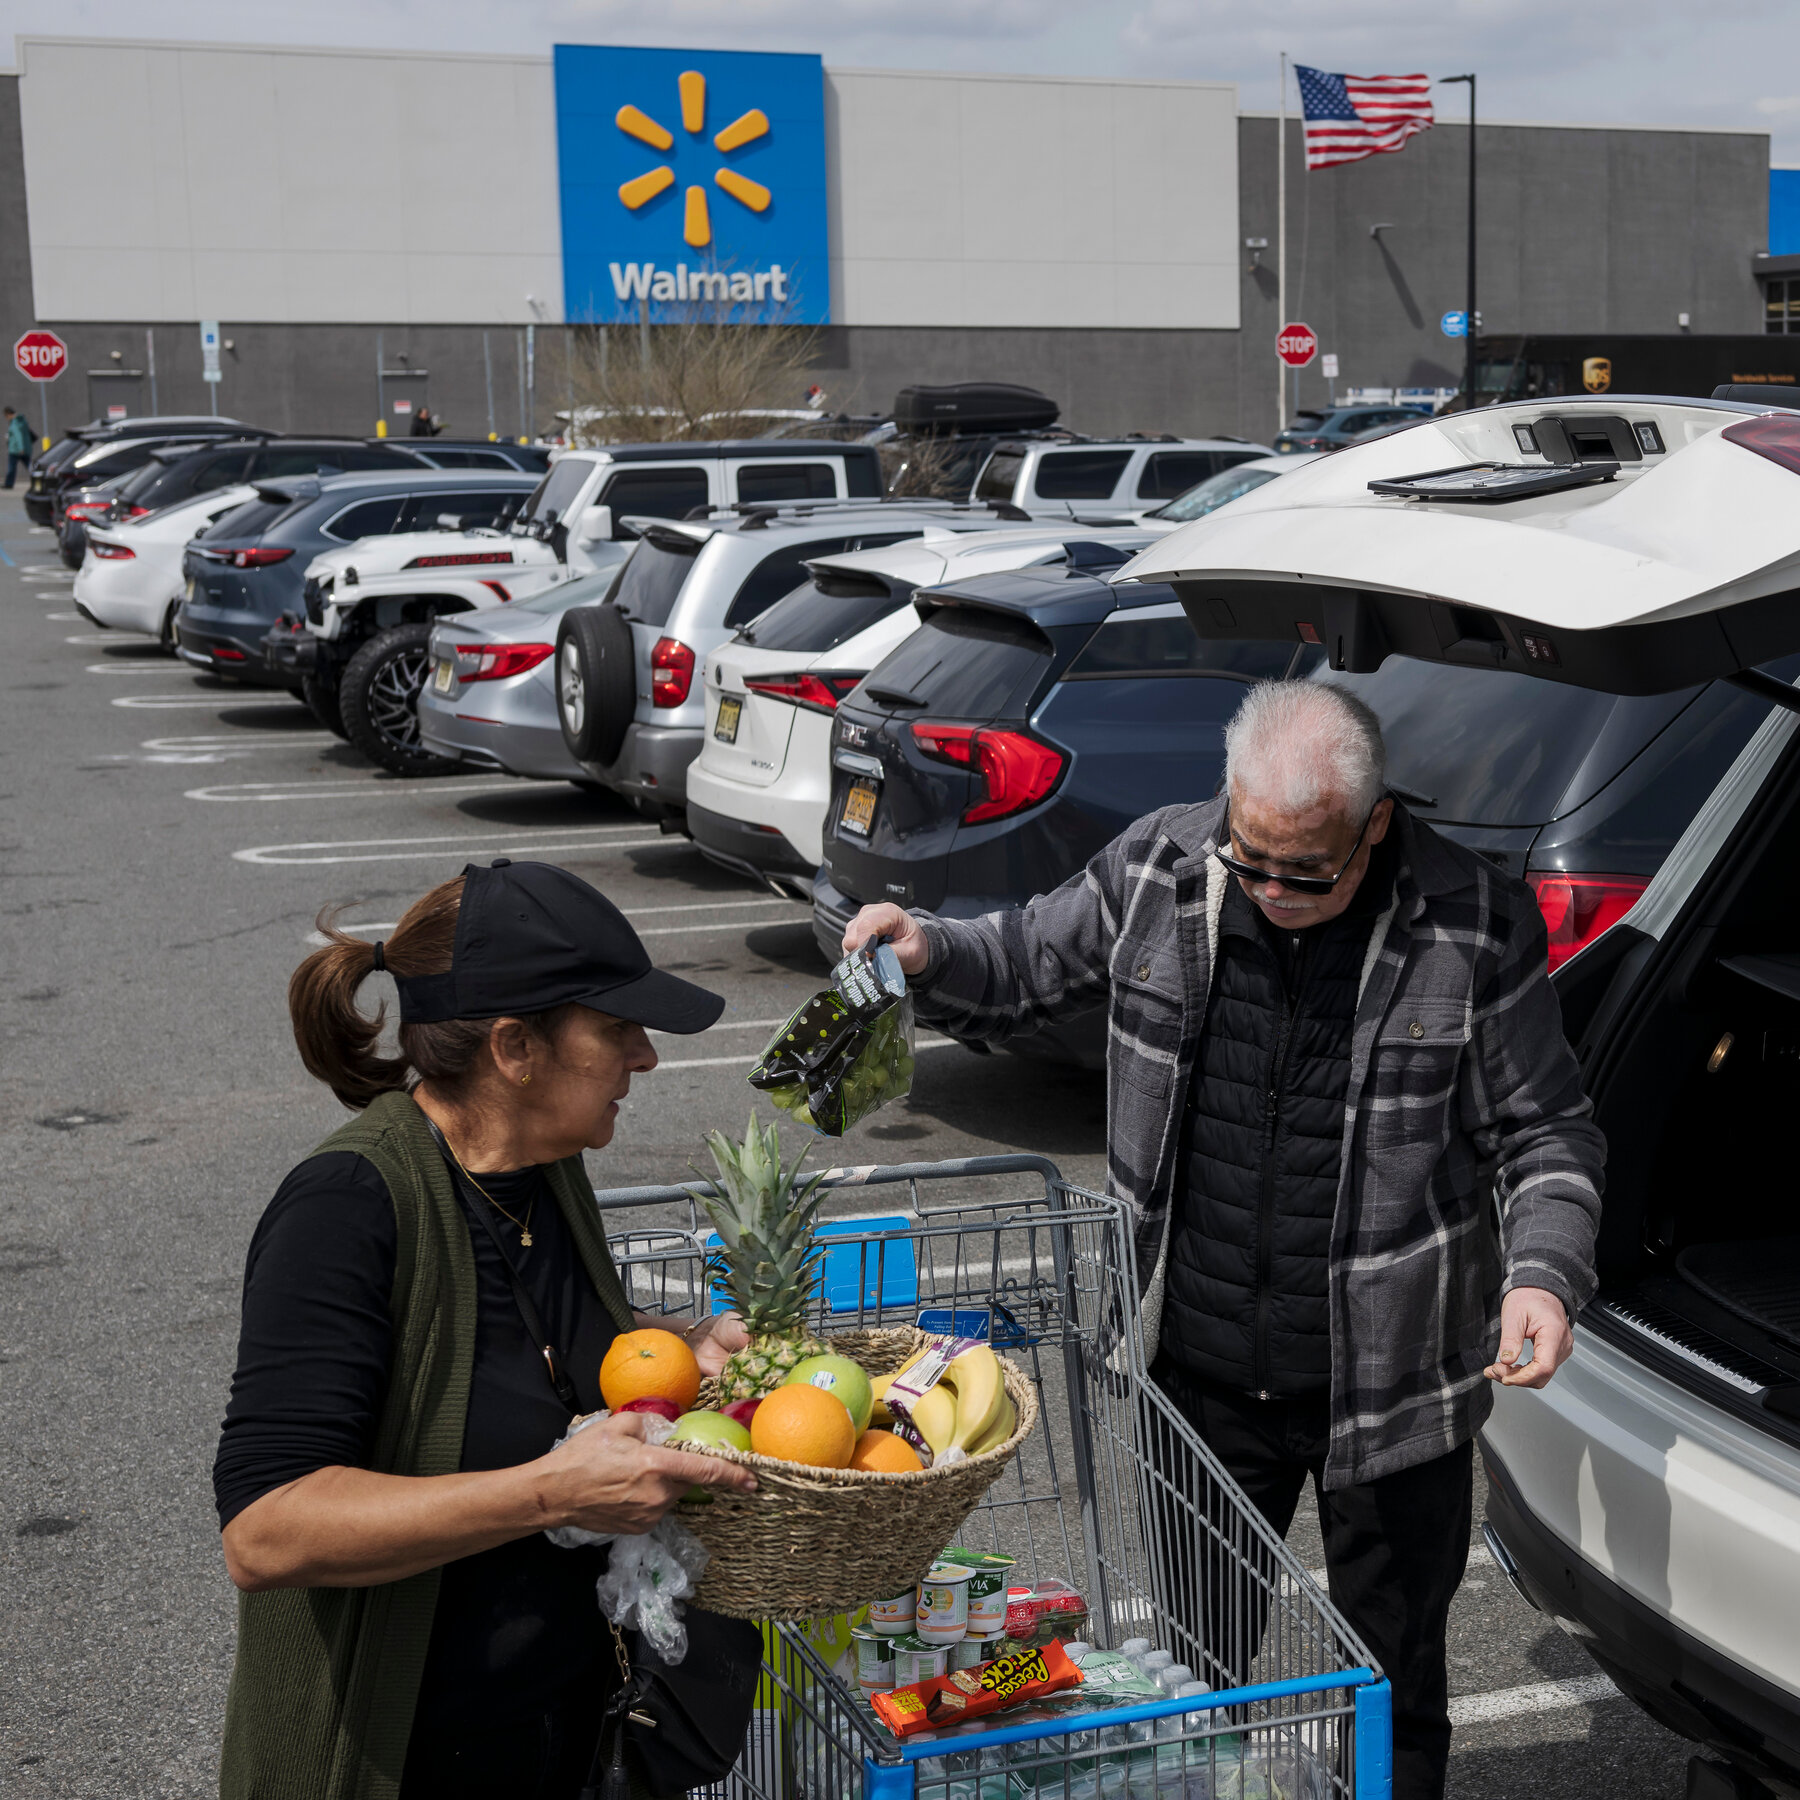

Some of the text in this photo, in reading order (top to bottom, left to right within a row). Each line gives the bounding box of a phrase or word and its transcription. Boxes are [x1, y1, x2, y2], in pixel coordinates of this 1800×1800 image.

[608, 262, 787, 301] Walmart
[19, 345, 62, 366] STOP
[1280, 336, 1313, 353] STOP
[842, 974, 866, 1008] Grapes
[855, 963, 882, 1003] Seedless
[923, 1591, 933, 1607] 3
[995, 1657, 1049, 1700] Reese's
[1084, 1663, 1138, 1687] 35
[890, 1693, 920, 1707] SIZE
[898, 1701, 926, 1714] KING
